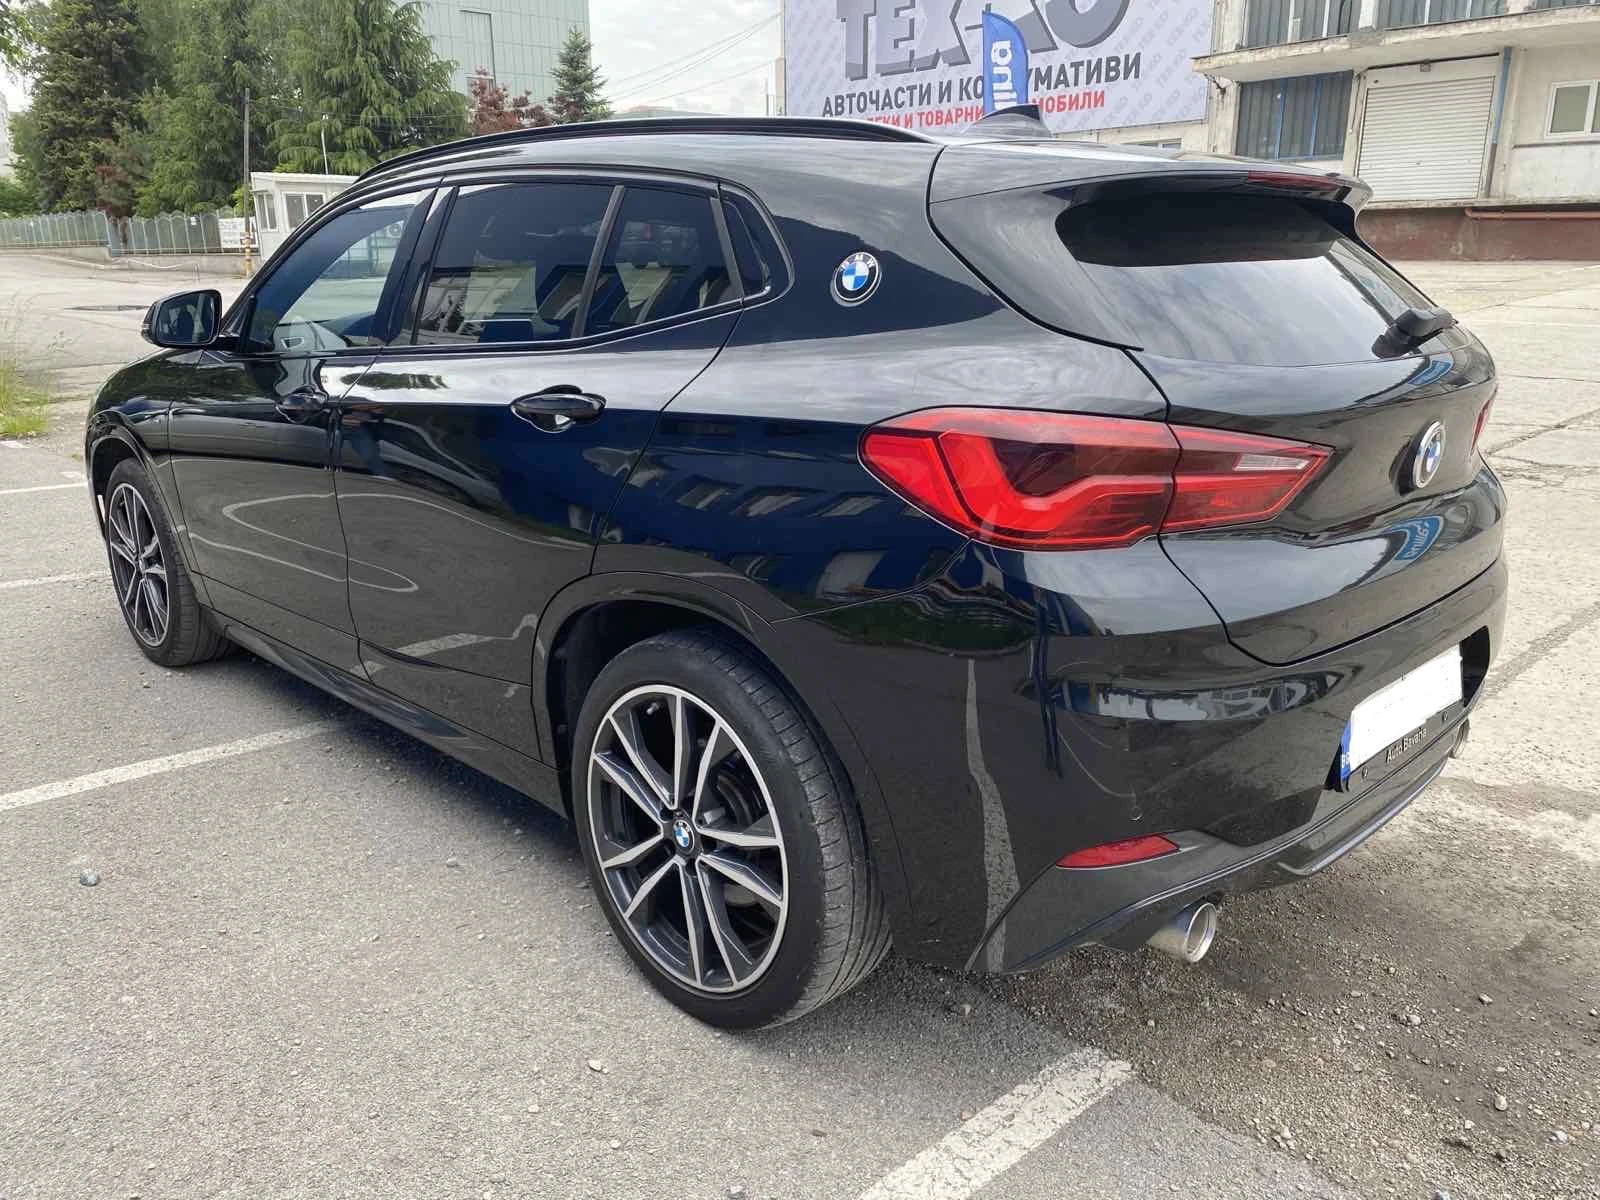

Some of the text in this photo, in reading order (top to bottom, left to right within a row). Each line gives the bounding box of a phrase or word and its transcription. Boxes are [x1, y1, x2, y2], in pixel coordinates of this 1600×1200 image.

[822, 52, 1141, 117] АВТОЧАСТИ И КОМАТИВИ
